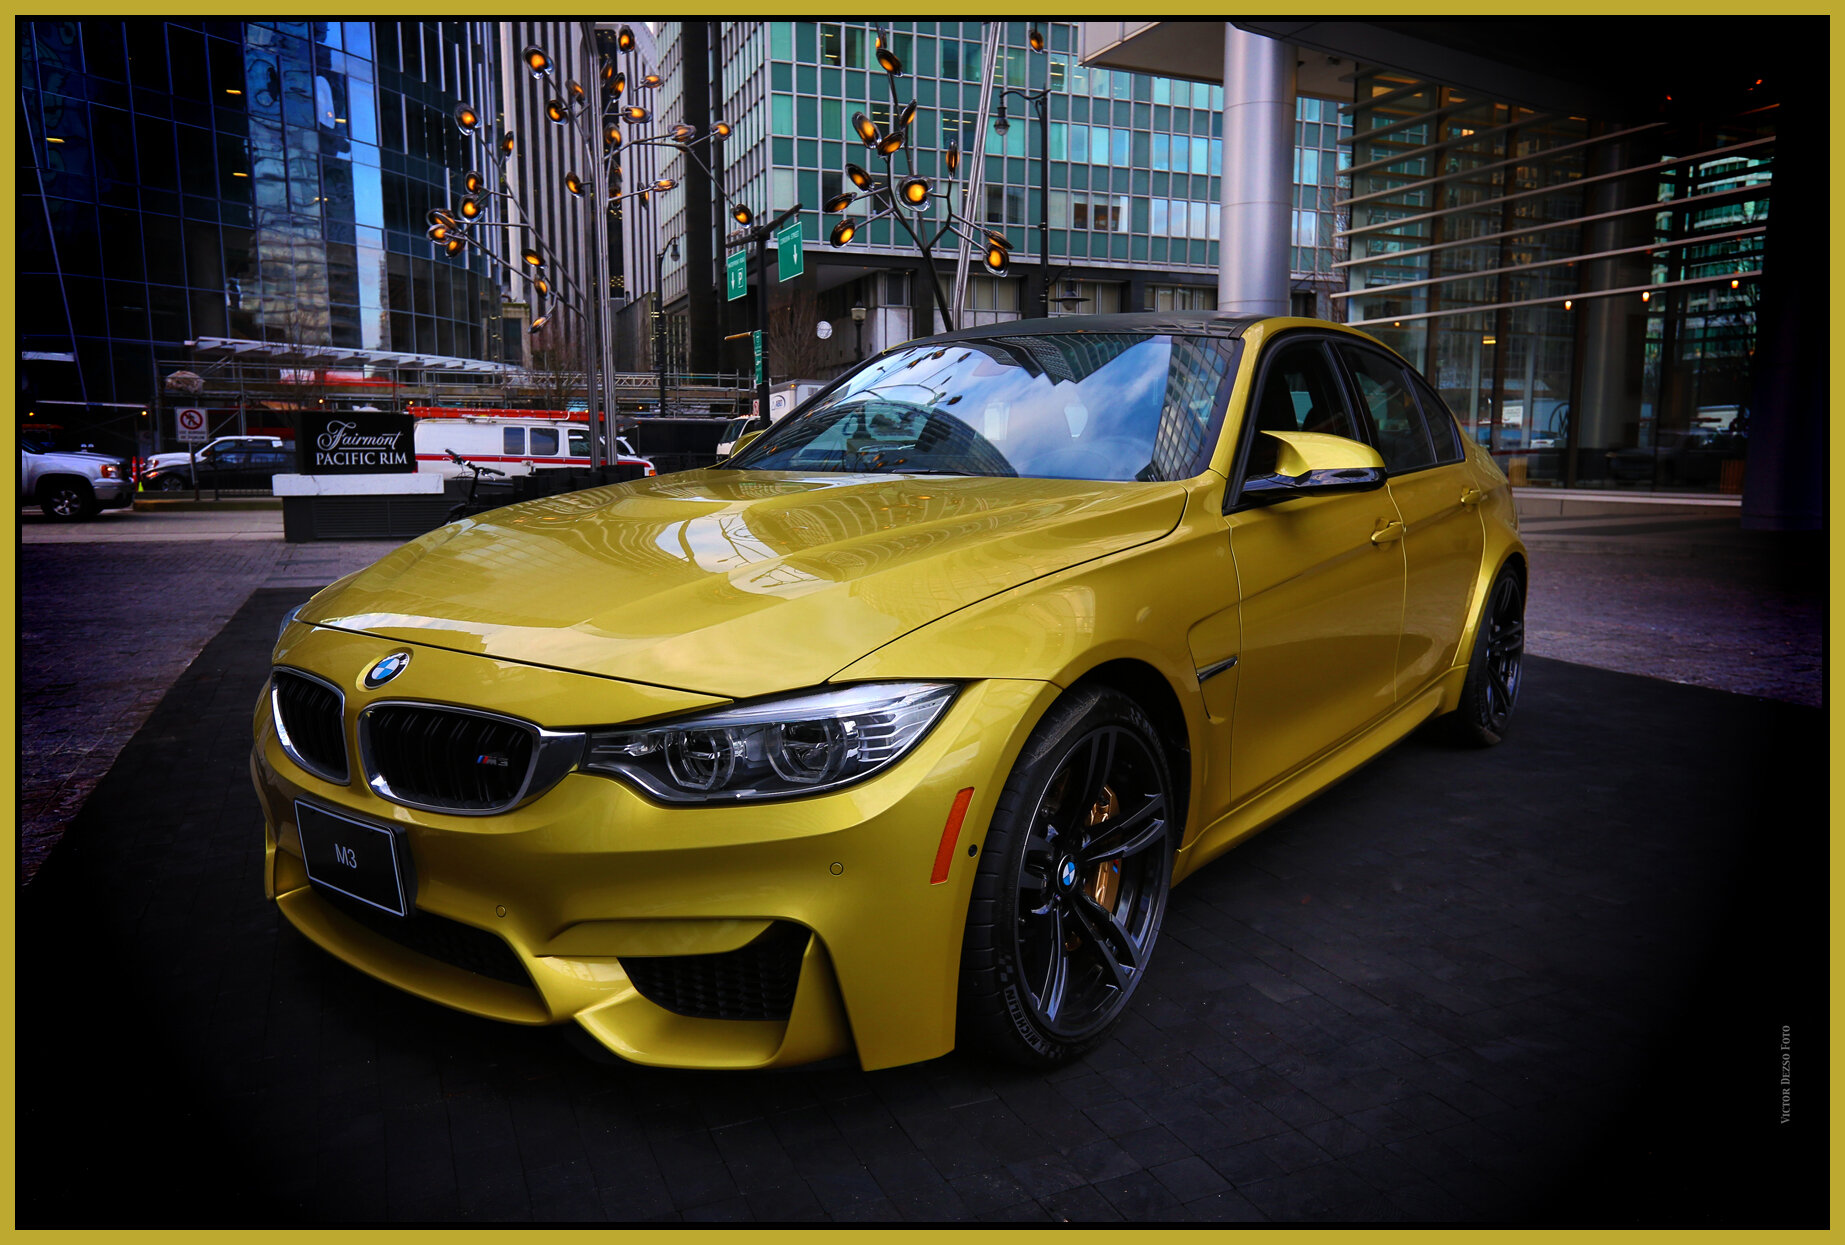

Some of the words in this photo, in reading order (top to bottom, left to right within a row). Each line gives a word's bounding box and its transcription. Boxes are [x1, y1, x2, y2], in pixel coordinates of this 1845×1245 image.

[317, 420, 404, 451] Fairmont
[316, 452, 376, 465] PACIFIC
[380, 452, 408, 465] RIM
[334, 843, 357, 869] M3
[1004, 988, 1042, 1047] MICHELIN
